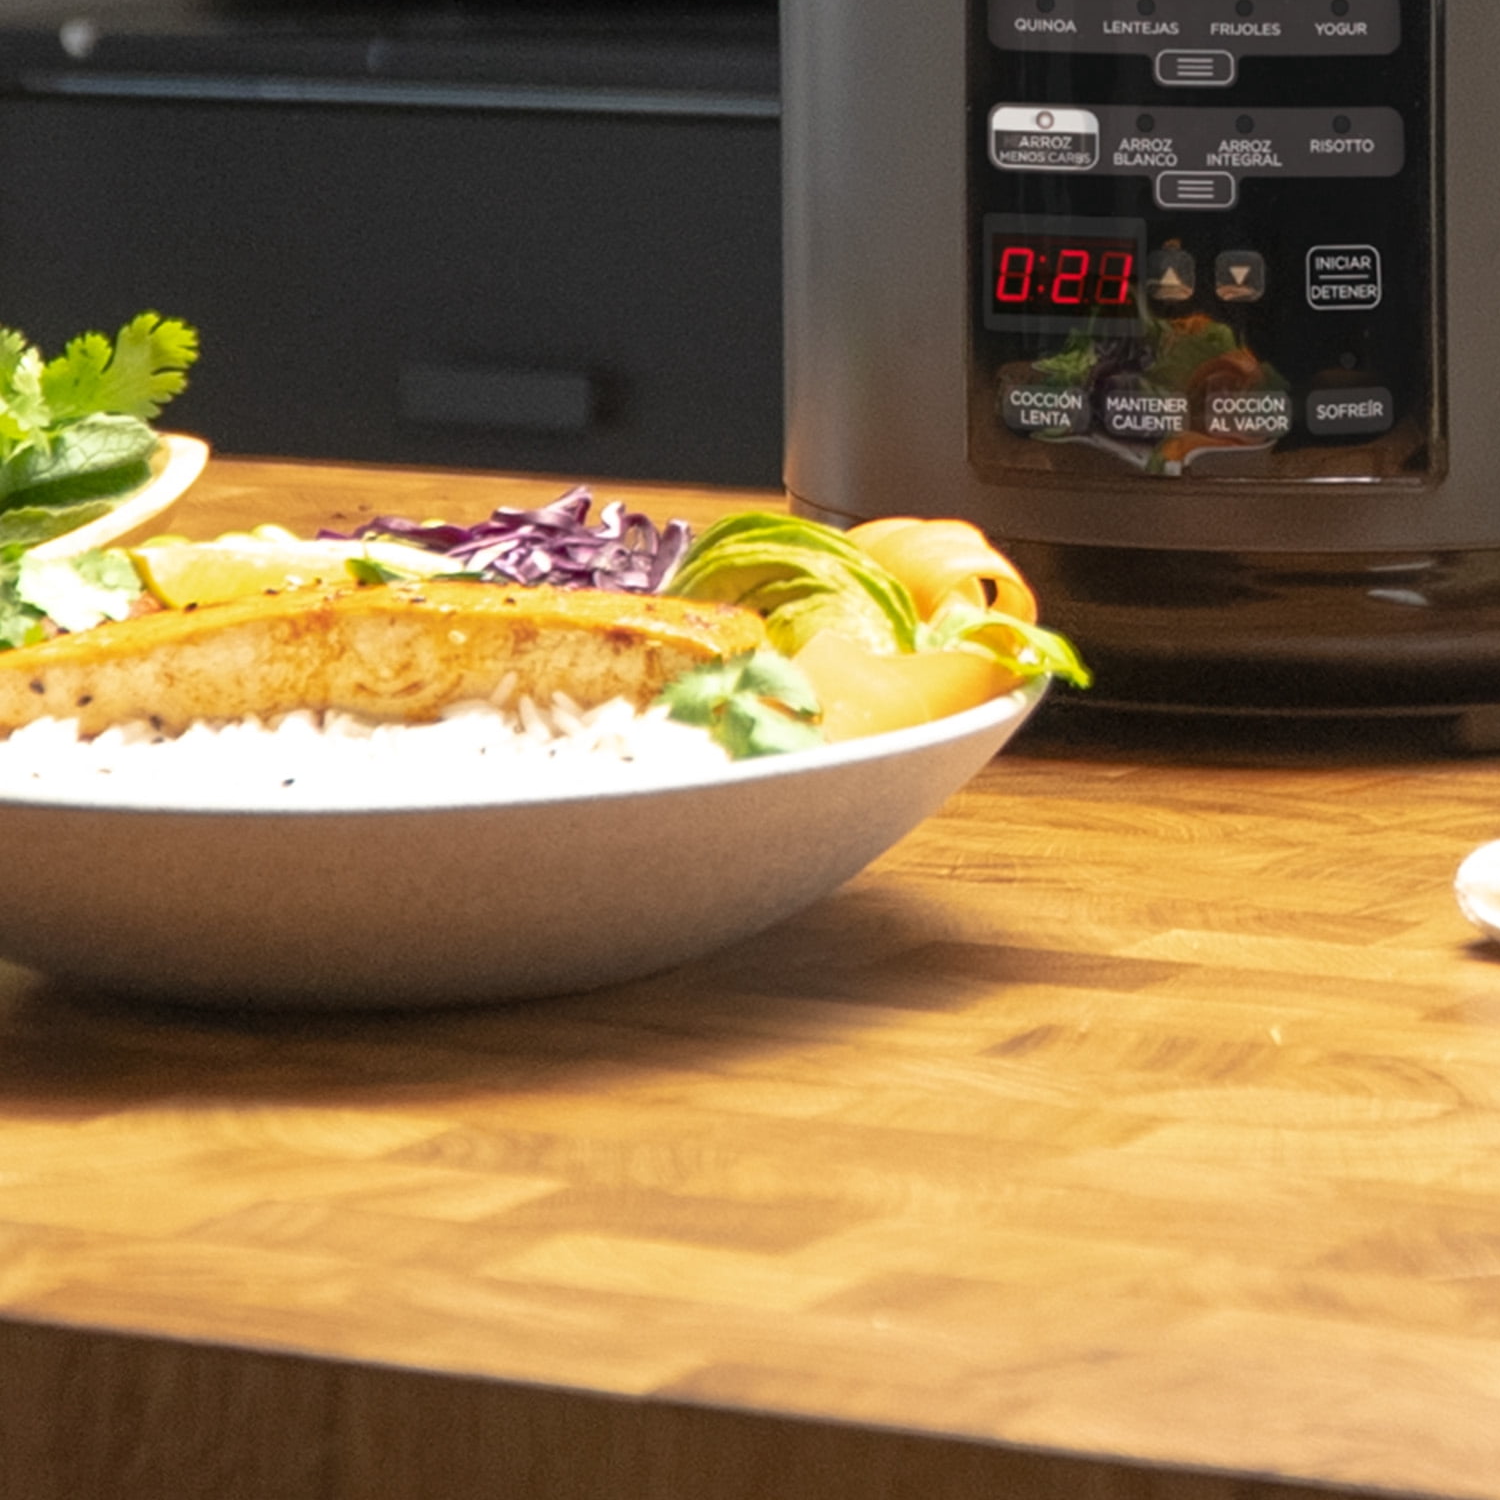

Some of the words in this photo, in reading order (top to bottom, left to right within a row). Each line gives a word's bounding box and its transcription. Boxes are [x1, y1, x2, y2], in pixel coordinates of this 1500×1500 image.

[1014, 18, 1077, 34] QUINOA
[1103, 20, 1180, 36] LENTEJAS
[1210, 22, 1281, 37] FRIJOLES
[1315, 22, 1368, 37] YOGUR
[1018, 135, 1073, 150] ARROZ
[1119, 138, 1173, 153] ARROZ
[1218, 139, 1272, 153] ARROZ
[1310, 138, 1375, 154] RISOTTO
[999, 151, 1046, 164] MENOS
[1113, 152, 1178, 168] BLANCO
[1206, 153, 1282, 168] INTEGRAL
[1315, 255, 1371, 271] INICIAR
[996, 247, 1133, 303] 0:21
[1311, 284, 1378, 300] DETENER
[1010, 390, 1083, 410] COCCIÓN
[1106, 396, 1188, 414] MANTENER
[1212, 395, 1286, 414] COCCIÓN
[1316, 401, 1384, 419] SOFREÍR
[1020, 409, 1072, 428] LENTA
[1112, 416, 1183, 432] CALIENTE
[1209, 417, 1231, 431] AL
[1234, 416, 1289, 432] VAPOR
